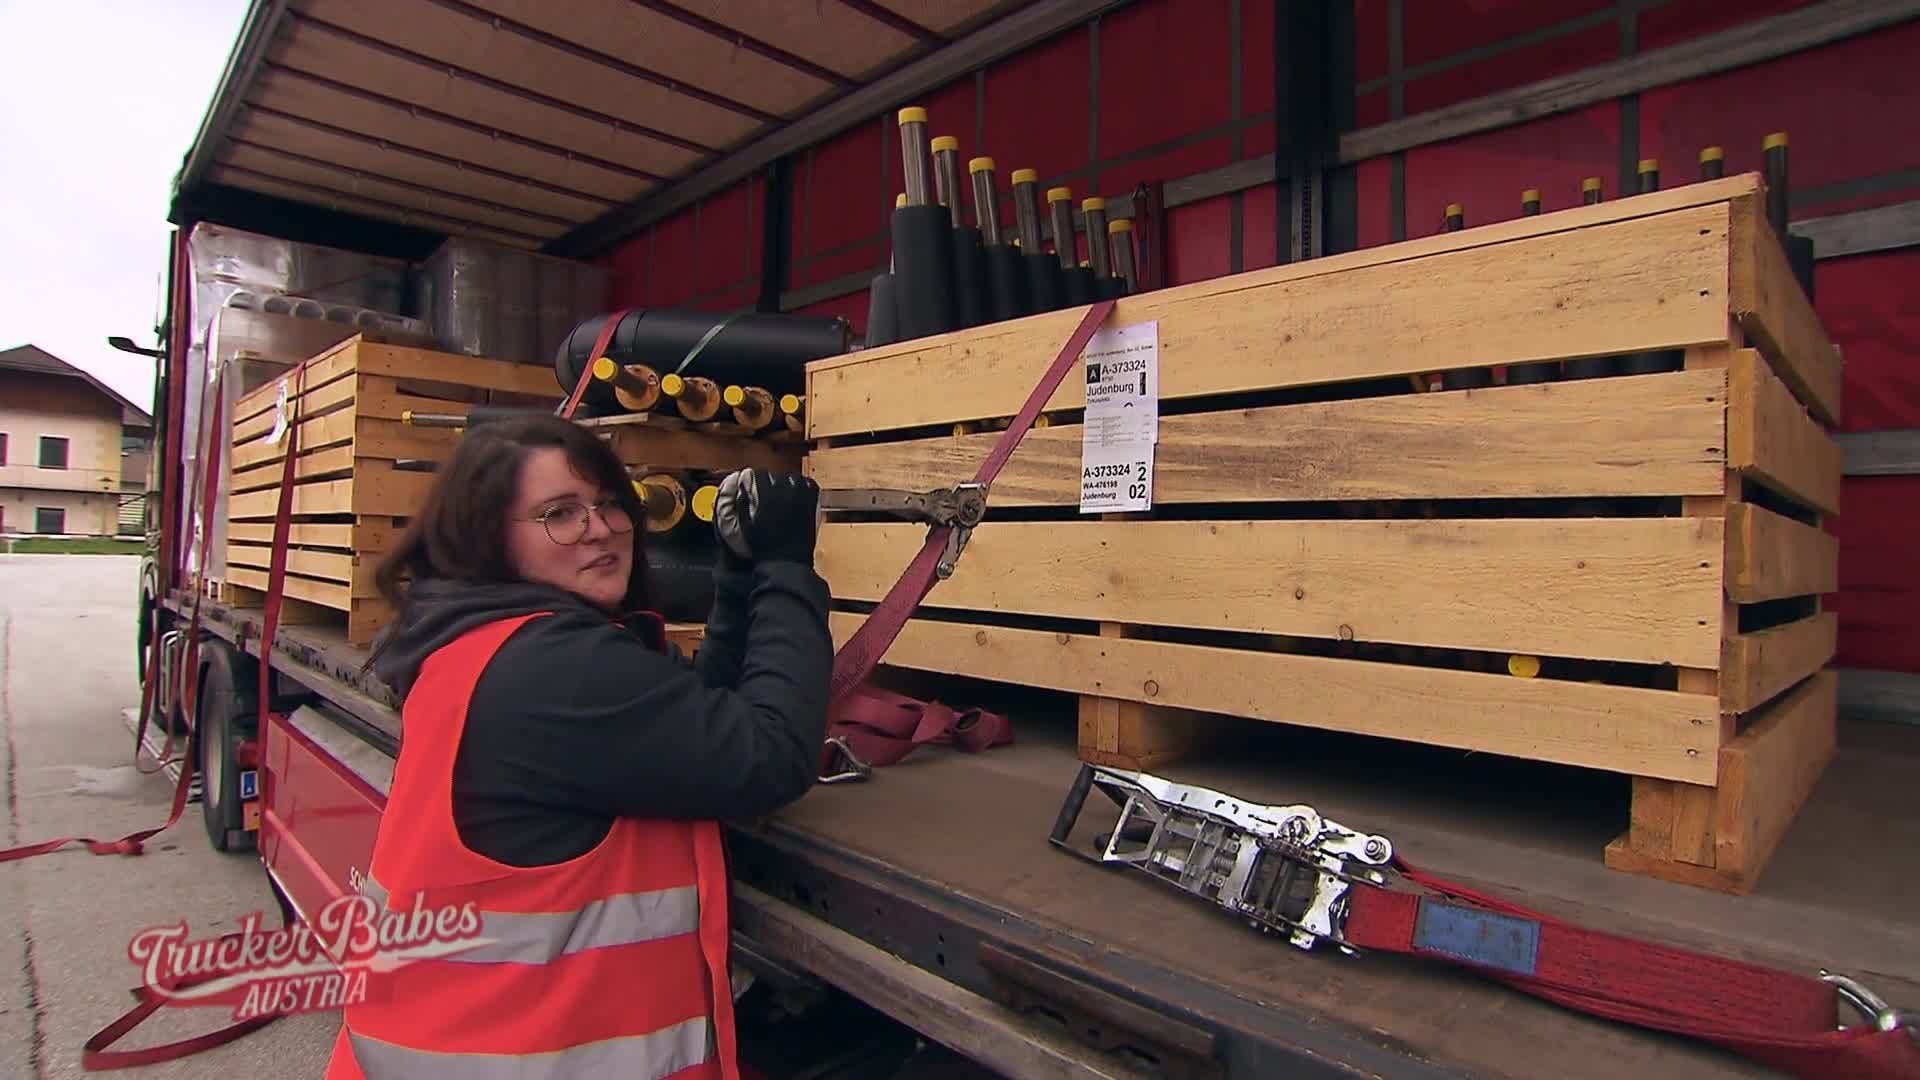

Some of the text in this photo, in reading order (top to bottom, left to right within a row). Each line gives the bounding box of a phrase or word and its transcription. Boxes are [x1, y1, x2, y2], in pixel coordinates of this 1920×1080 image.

[1102, 360, 1146, 375] A-373324
[1087, 384, 1134, 396] Judenburg
[1083, 464, 1131, 478] A-373324
[1137, 466, 1147, 482] 2
[1083, 492, 1117, 500] Judenburg
[1129, 484, 1146, 499] 02
